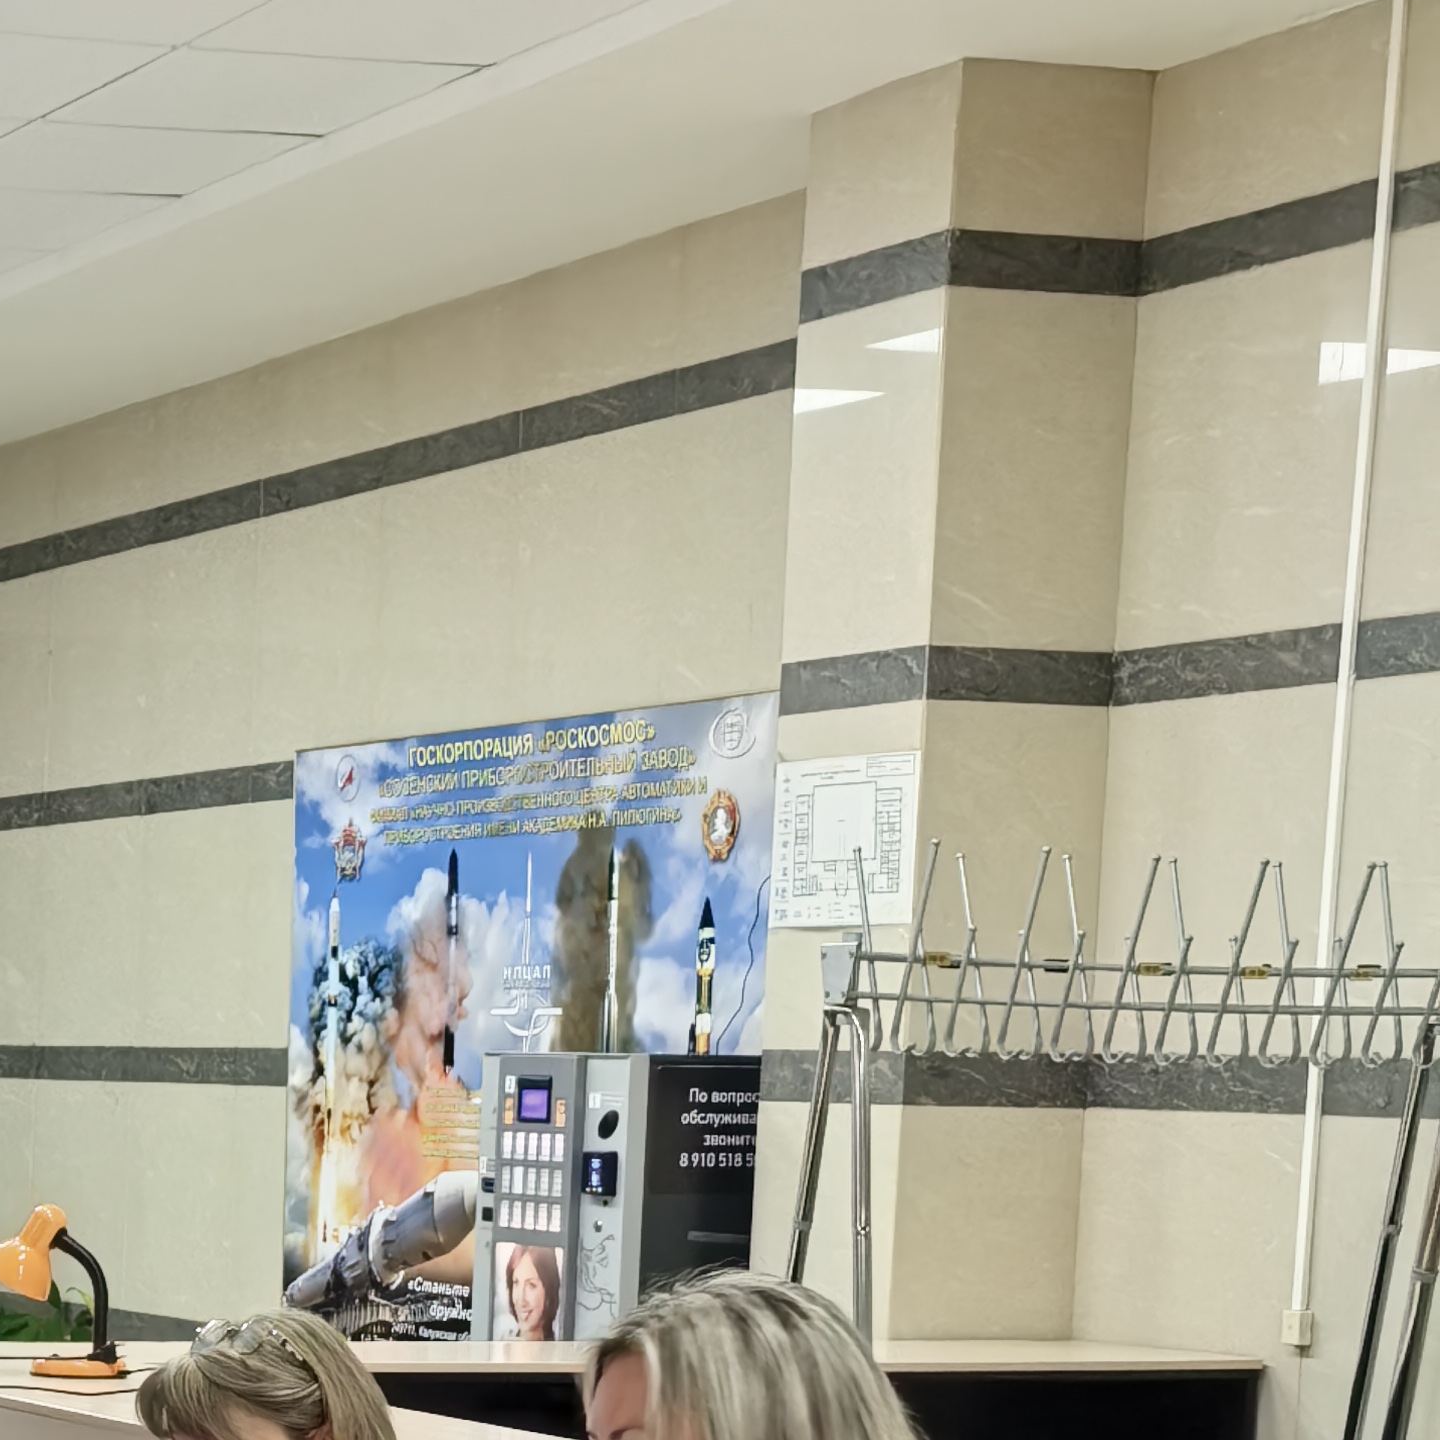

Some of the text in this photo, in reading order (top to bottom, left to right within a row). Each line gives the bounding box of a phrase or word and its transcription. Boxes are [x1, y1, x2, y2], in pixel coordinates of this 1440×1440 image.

[408, 719, 656, 768] ГОСКОРПОРАЦИЯ «РОСКОСМОС»
[641, 745, 697, 772] ЗАВОД»
[689, 1087, 708, 1103] По
[679, 1152, 689, 1168] 8
[691, 1152, 716, 1168] 910
[718, 1152, 743, 1168] 518
